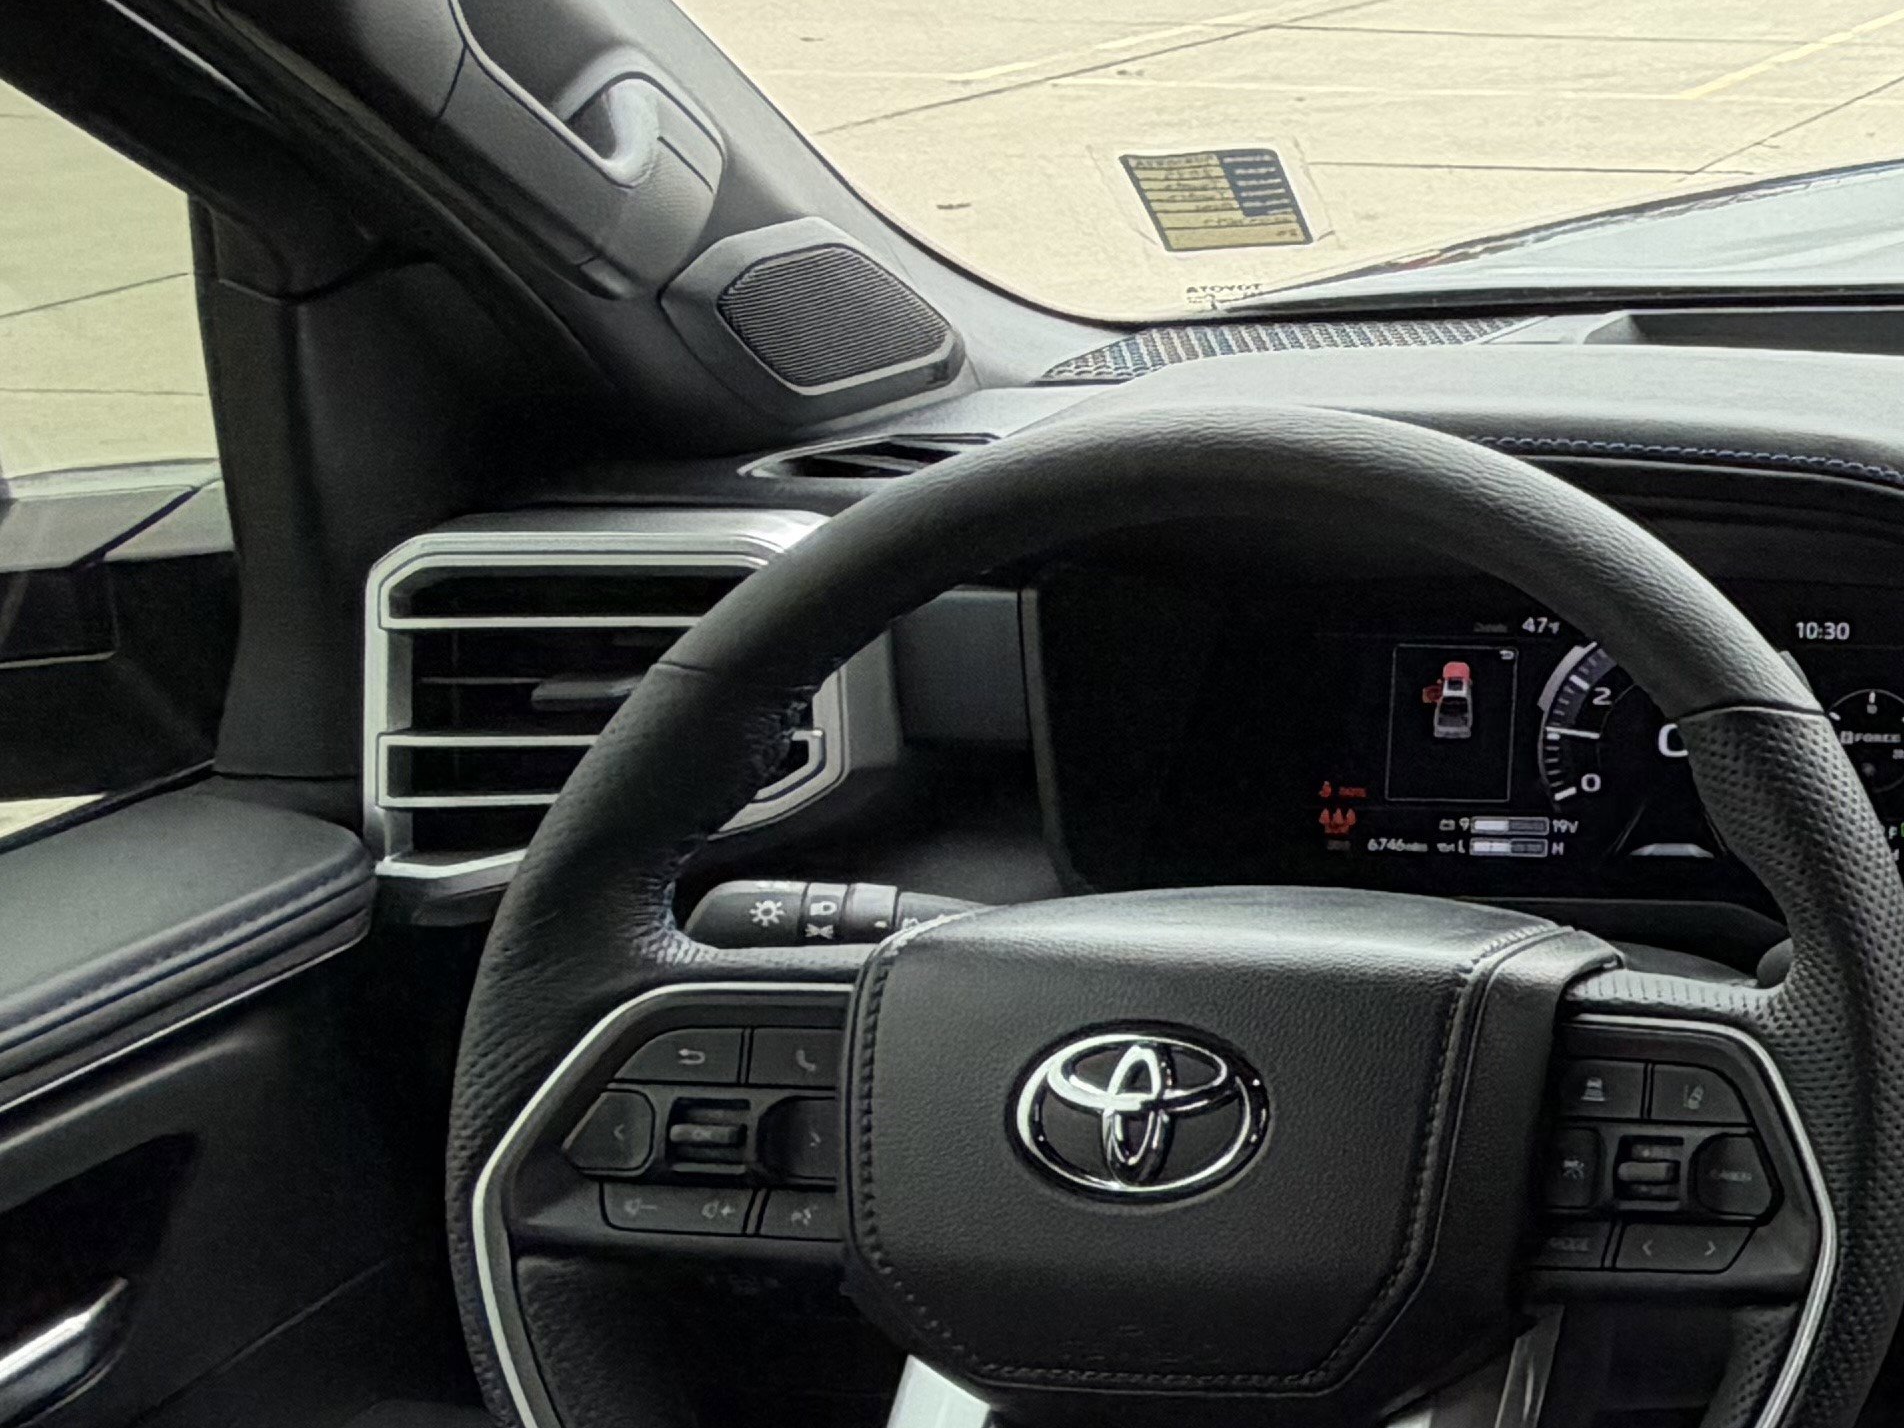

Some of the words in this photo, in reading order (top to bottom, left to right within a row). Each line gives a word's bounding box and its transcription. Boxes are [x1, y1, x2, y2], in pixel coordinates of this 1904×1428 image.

[1795, 620, 1851, 641] 10:30
[1591, 685, 1613, 706] 2
[1580, 772, 1603, 794] 0
